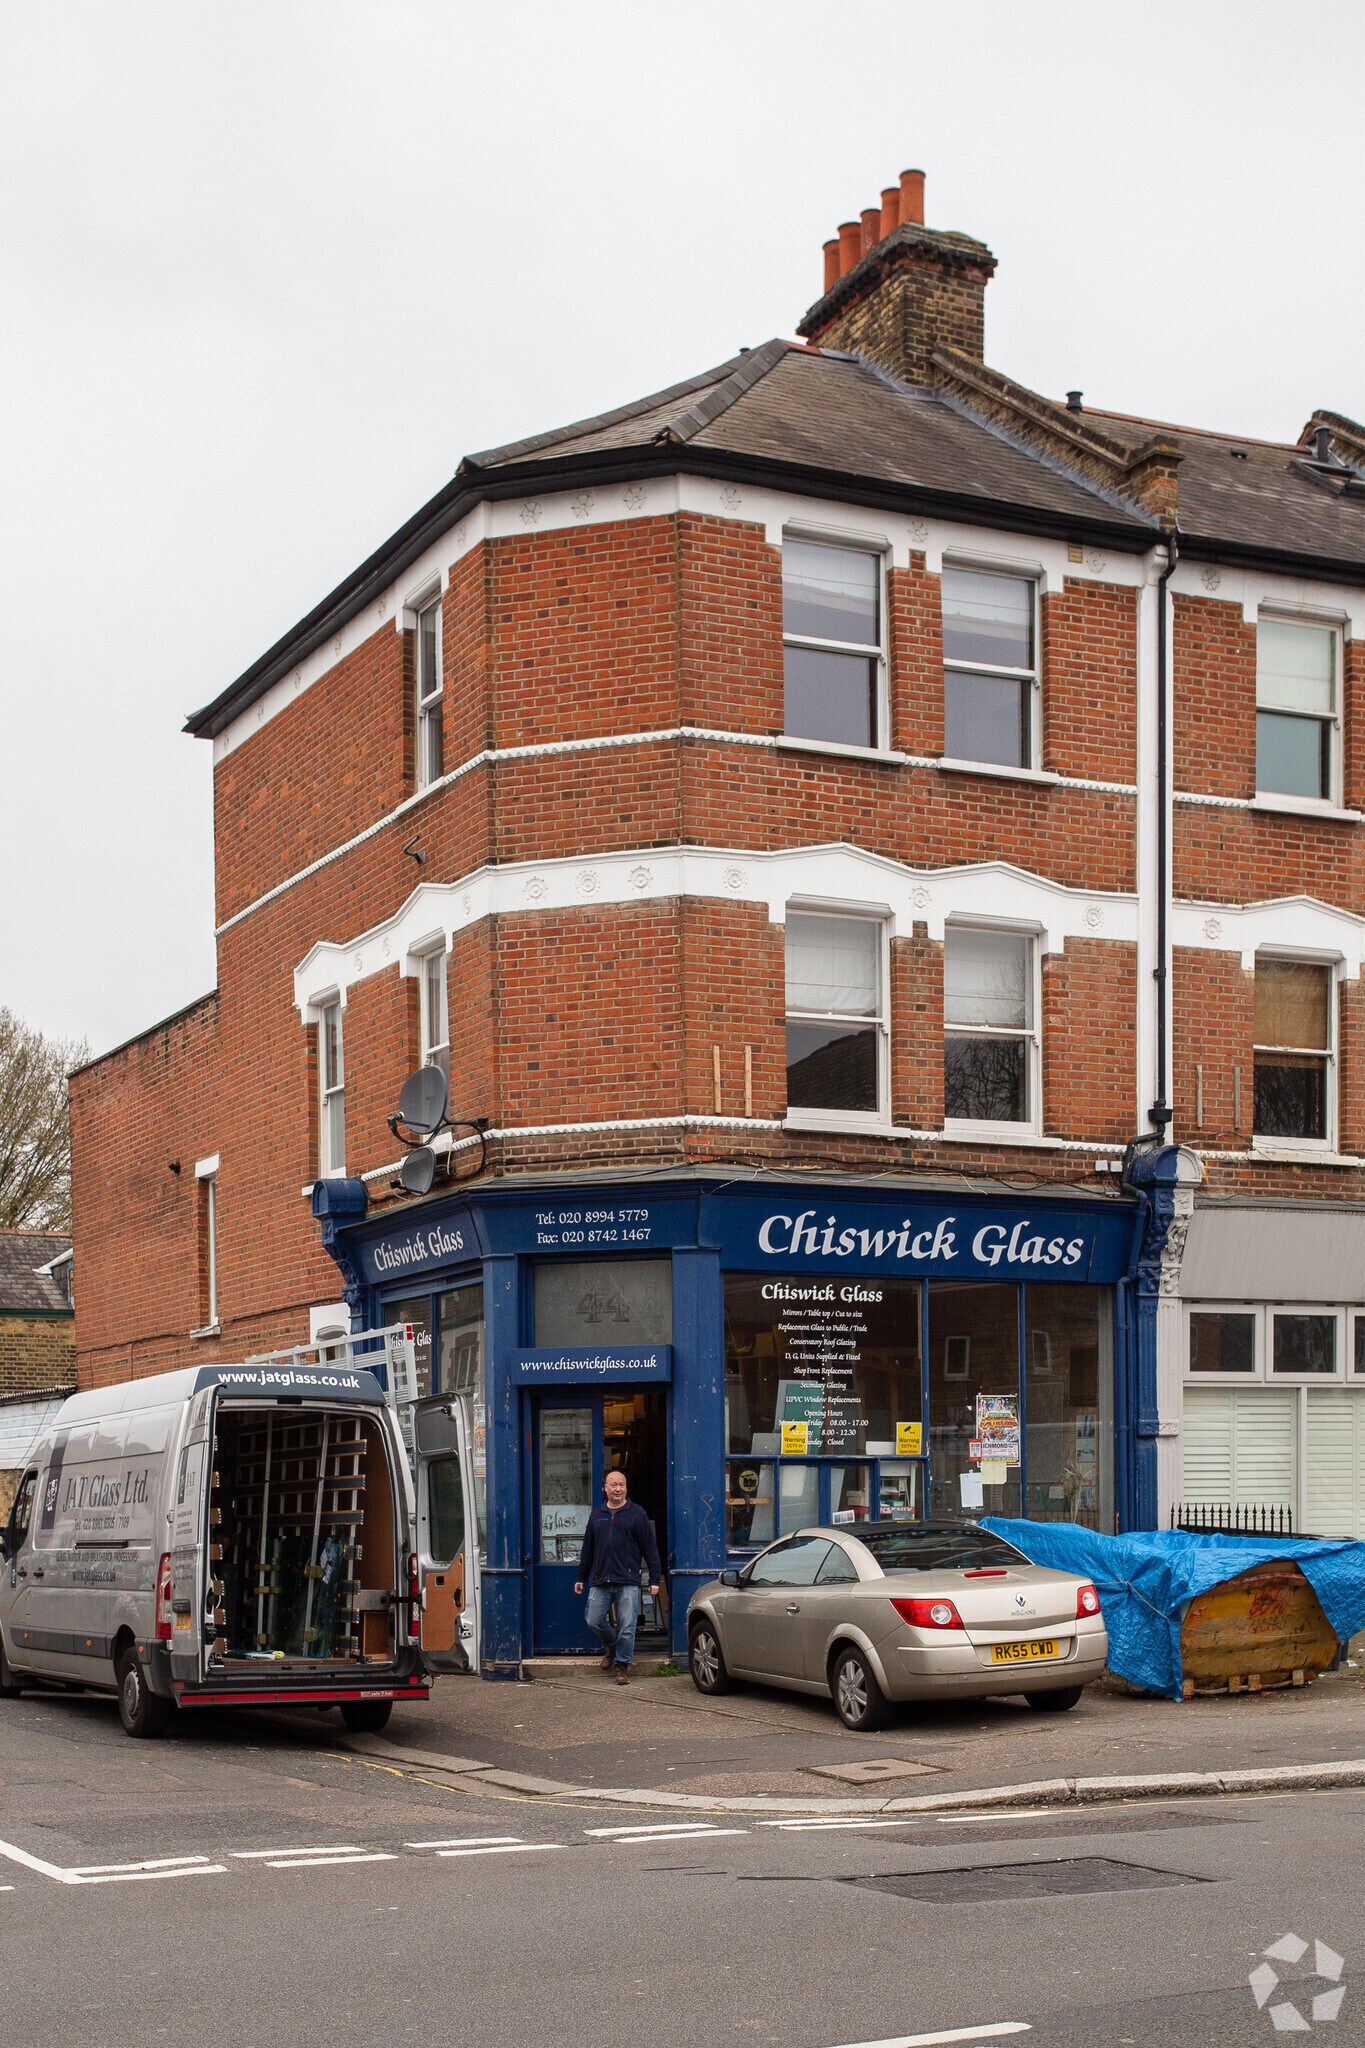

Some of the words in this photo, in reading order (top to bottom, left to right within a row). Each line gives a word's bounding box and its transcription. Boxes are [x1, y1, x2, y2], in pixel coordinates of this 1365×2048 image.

[535, 1211, 555, 1225] Tel:
[559, 1212, 581, 1224] 020
[585, 1211, 615, 1223] 8994
[618, 1209, 649, 1222] 5779
[536, 1232, 558, 1244] Fax:
[561, 1231, 584, 1243] 020
[588, 1229, 618, 1242] 8742
[622, 1228, 651, 1241] 1467
[757, 1210, 959, 1260] Chiswick
[972, 1220, 1084, 1267] Glass
[374, 1232, 429, 1271] Chiswick
[428, 1226, 464, 1258] Glass
[761, 1282, 837, 1301] Chiswick
[840, 1285, 883, 1304] Glass
[782, 1309, 803, 1317] Mirrors
[807, 1309, 821, 1317] Table
[822, 1311, 831, 1319] top
[777, 1323, 810, 1332] Replacement
[810, 1324, 825, 1332] Glass
[832, 1324, 849, 1332] Public
[416, 1330, 432, 1347] Glas
[789, 1338, 823, 1348] Conservatory
[823, 1339, 837, 1348] Roof
[836, 1339, 857, 1348] Glazing
[520, 1355, 657, 1373] www.chiswickglass.co.uk
[815, 1353, 838, 1362] Supplied
[845, 1353, 861, 1361] Fitted
[218, 1370, 360, 1388] www.jatglass.co.uk
[793, 1366, 807, 1376] Shop
[821, 1367, 853, 1376] Replacement
[800, 1381, 825, 1391] Secondary
[826, 1381, 847, 1391] Glazing
[827, 1396, 861, 1405] Replacements
[804, 1410, 826, 1418] Opening
[827, 1438, 845, 1446] Closed
[62, 1476, 88, 1513] JAT
[89, 1474, 121, 1508] Glass
[122, 1469, 149, 1504] Ltd.
[995, 1644, 1028, 1660] RK55
[1030, 1641, 1054, 1656] CWD
